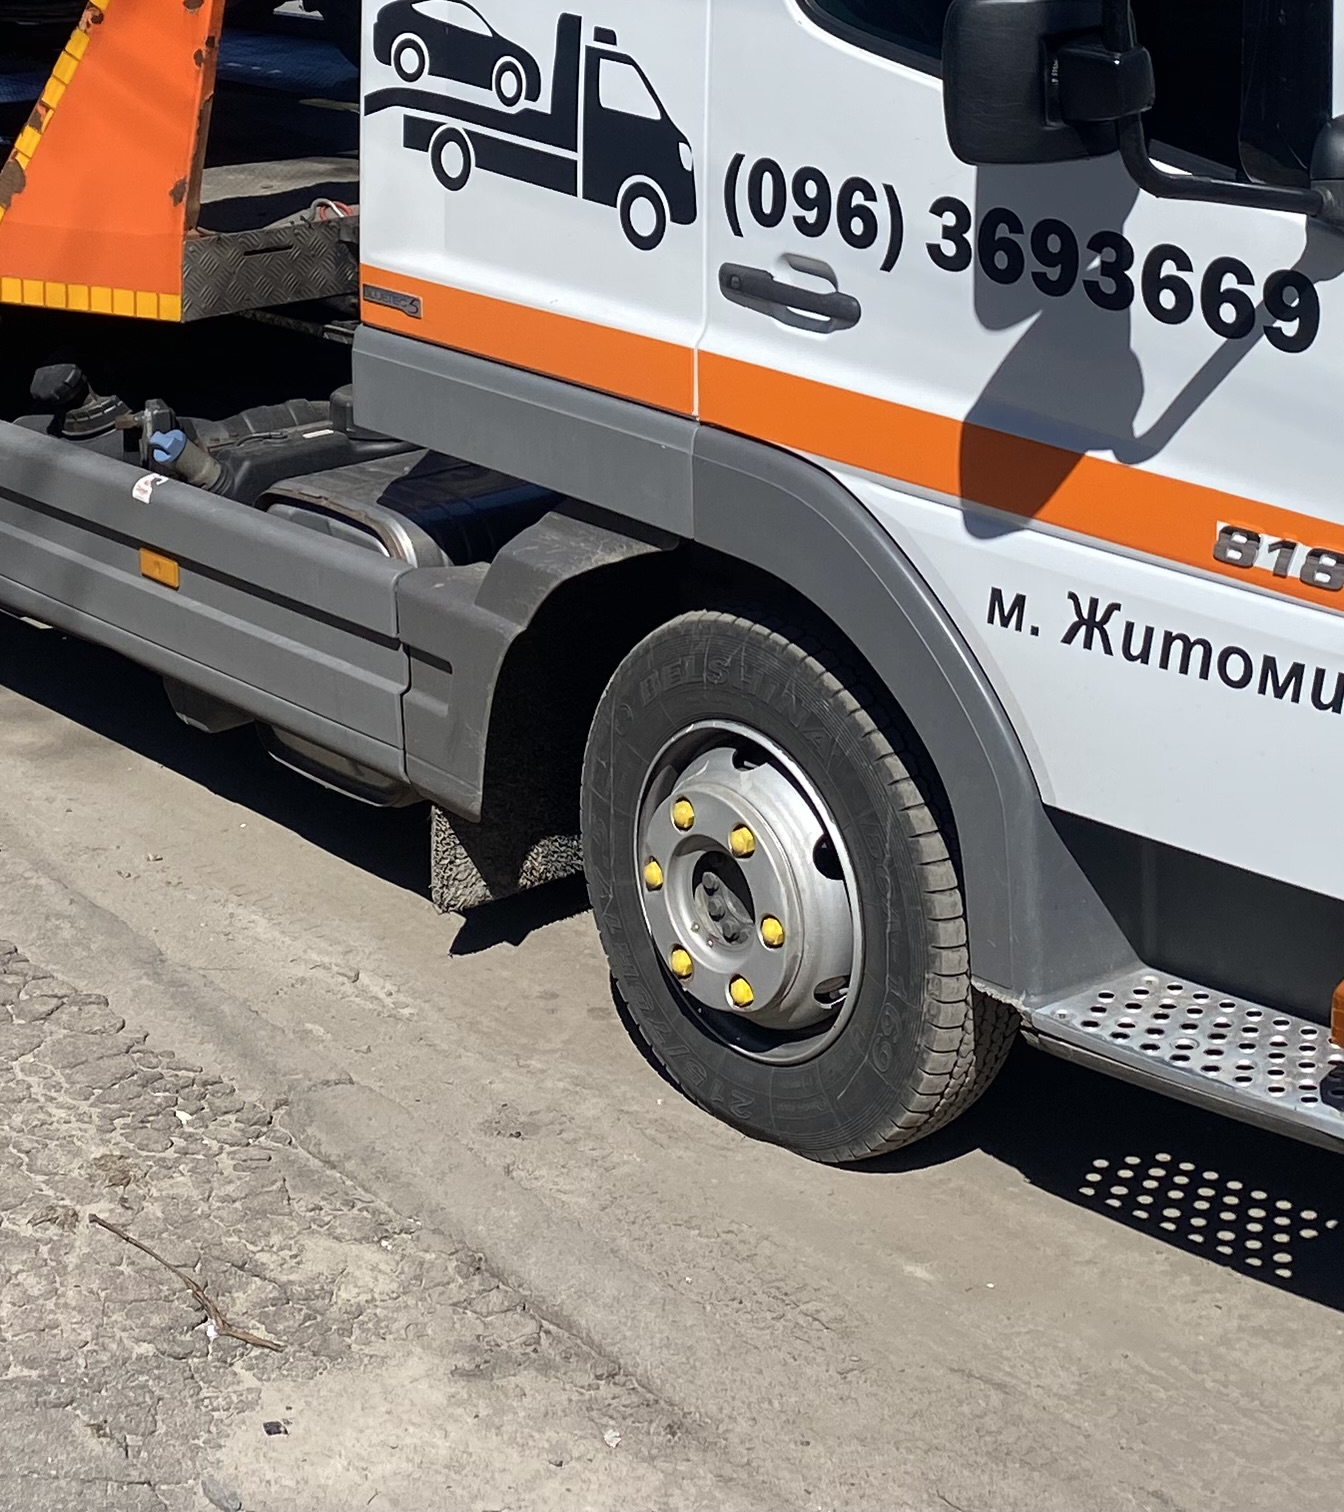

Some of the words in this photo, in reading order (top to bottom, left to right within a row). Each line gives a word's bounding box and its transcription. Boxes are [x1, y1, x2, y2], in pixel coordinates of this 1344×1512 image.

[723, 152, 904, 273] (096)
[925, 195, 1321, 354] 3693669
[986, 586, 1040, 637] м.
